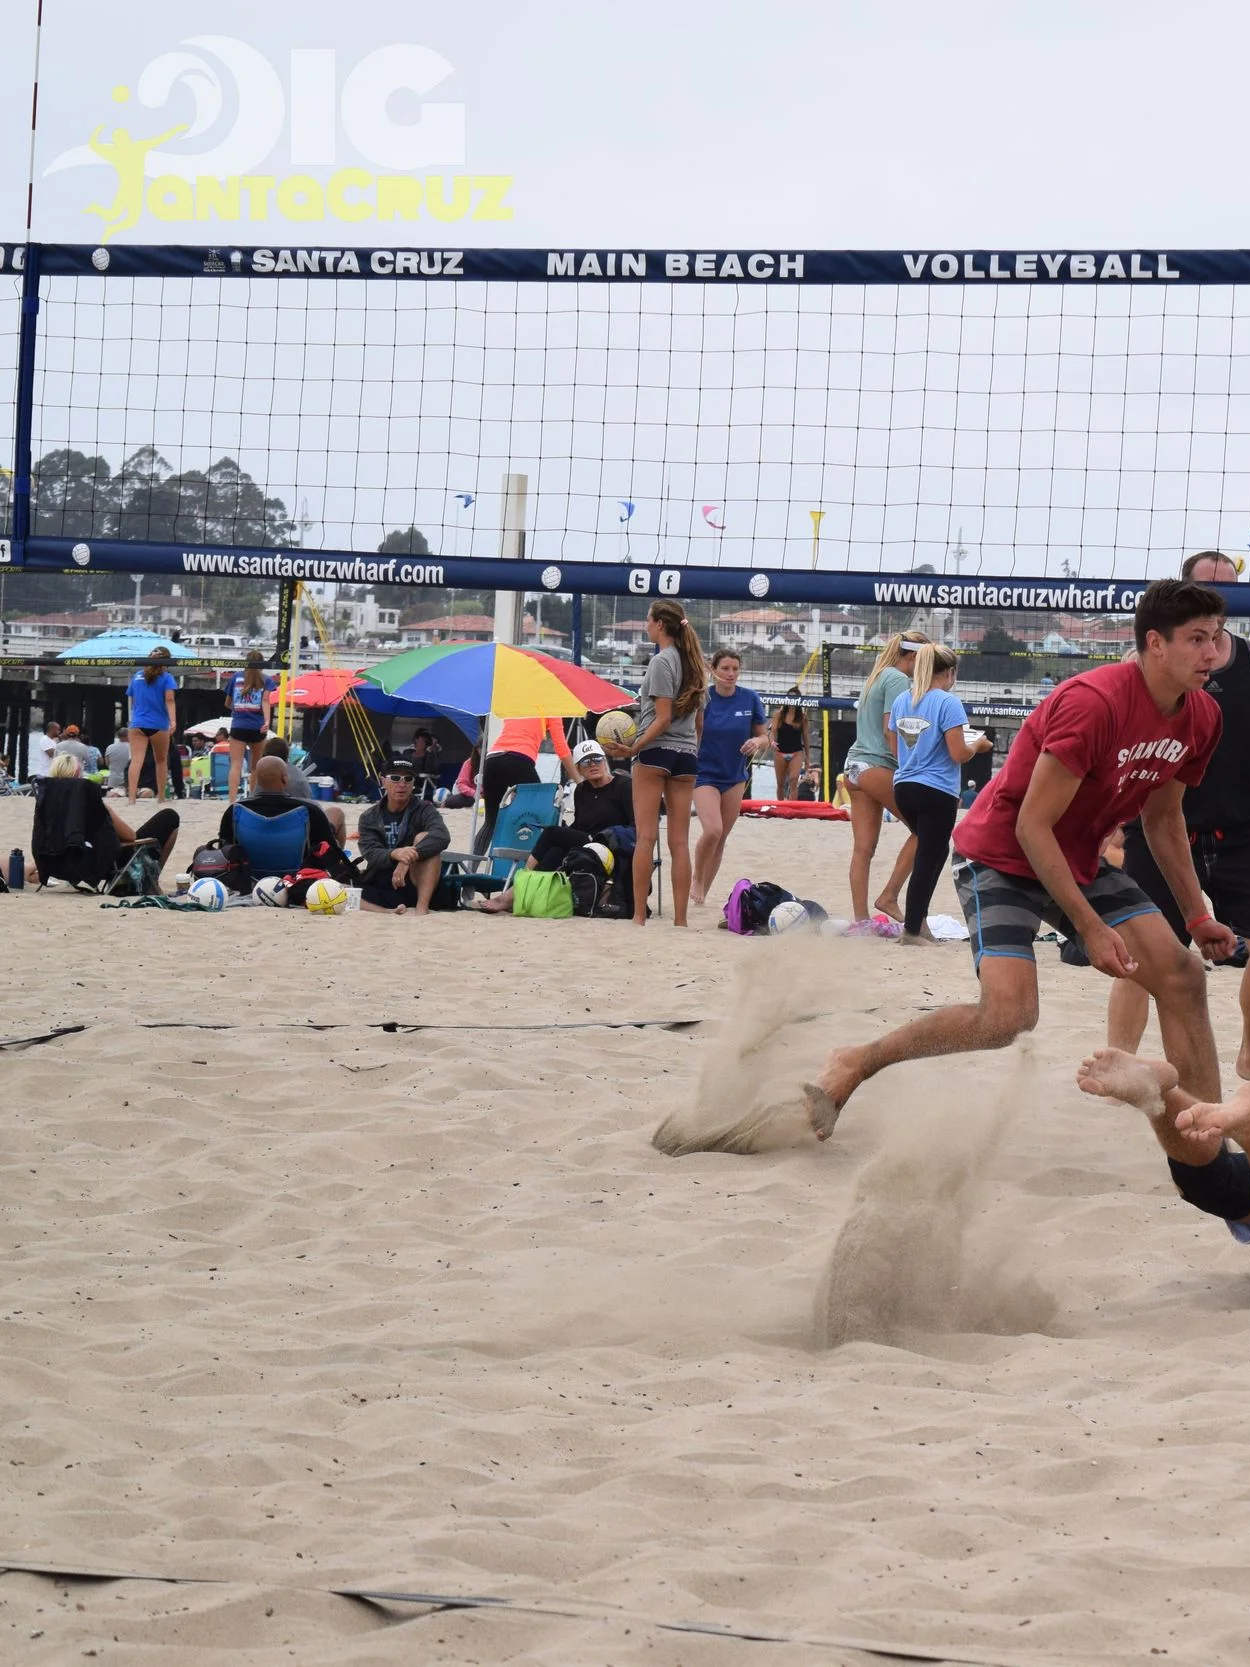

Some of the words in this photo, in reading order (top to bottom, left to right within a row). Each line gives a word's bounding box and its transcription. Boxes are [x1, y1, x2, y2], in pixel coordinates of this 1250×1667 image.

[252, 250, 360, 272] SANTA
[371, 251, 463, 274] CRUZ
[548, 253, 646, 275] MAIN
[666, 254, 804, 277] BEACH
[903, 254, 1179, 278] VOLLEYBALL
[183, 554, 443, 583] www.santacruzwharf.com
[873, 582, 1147, 609] www.santacruzwharf.co
